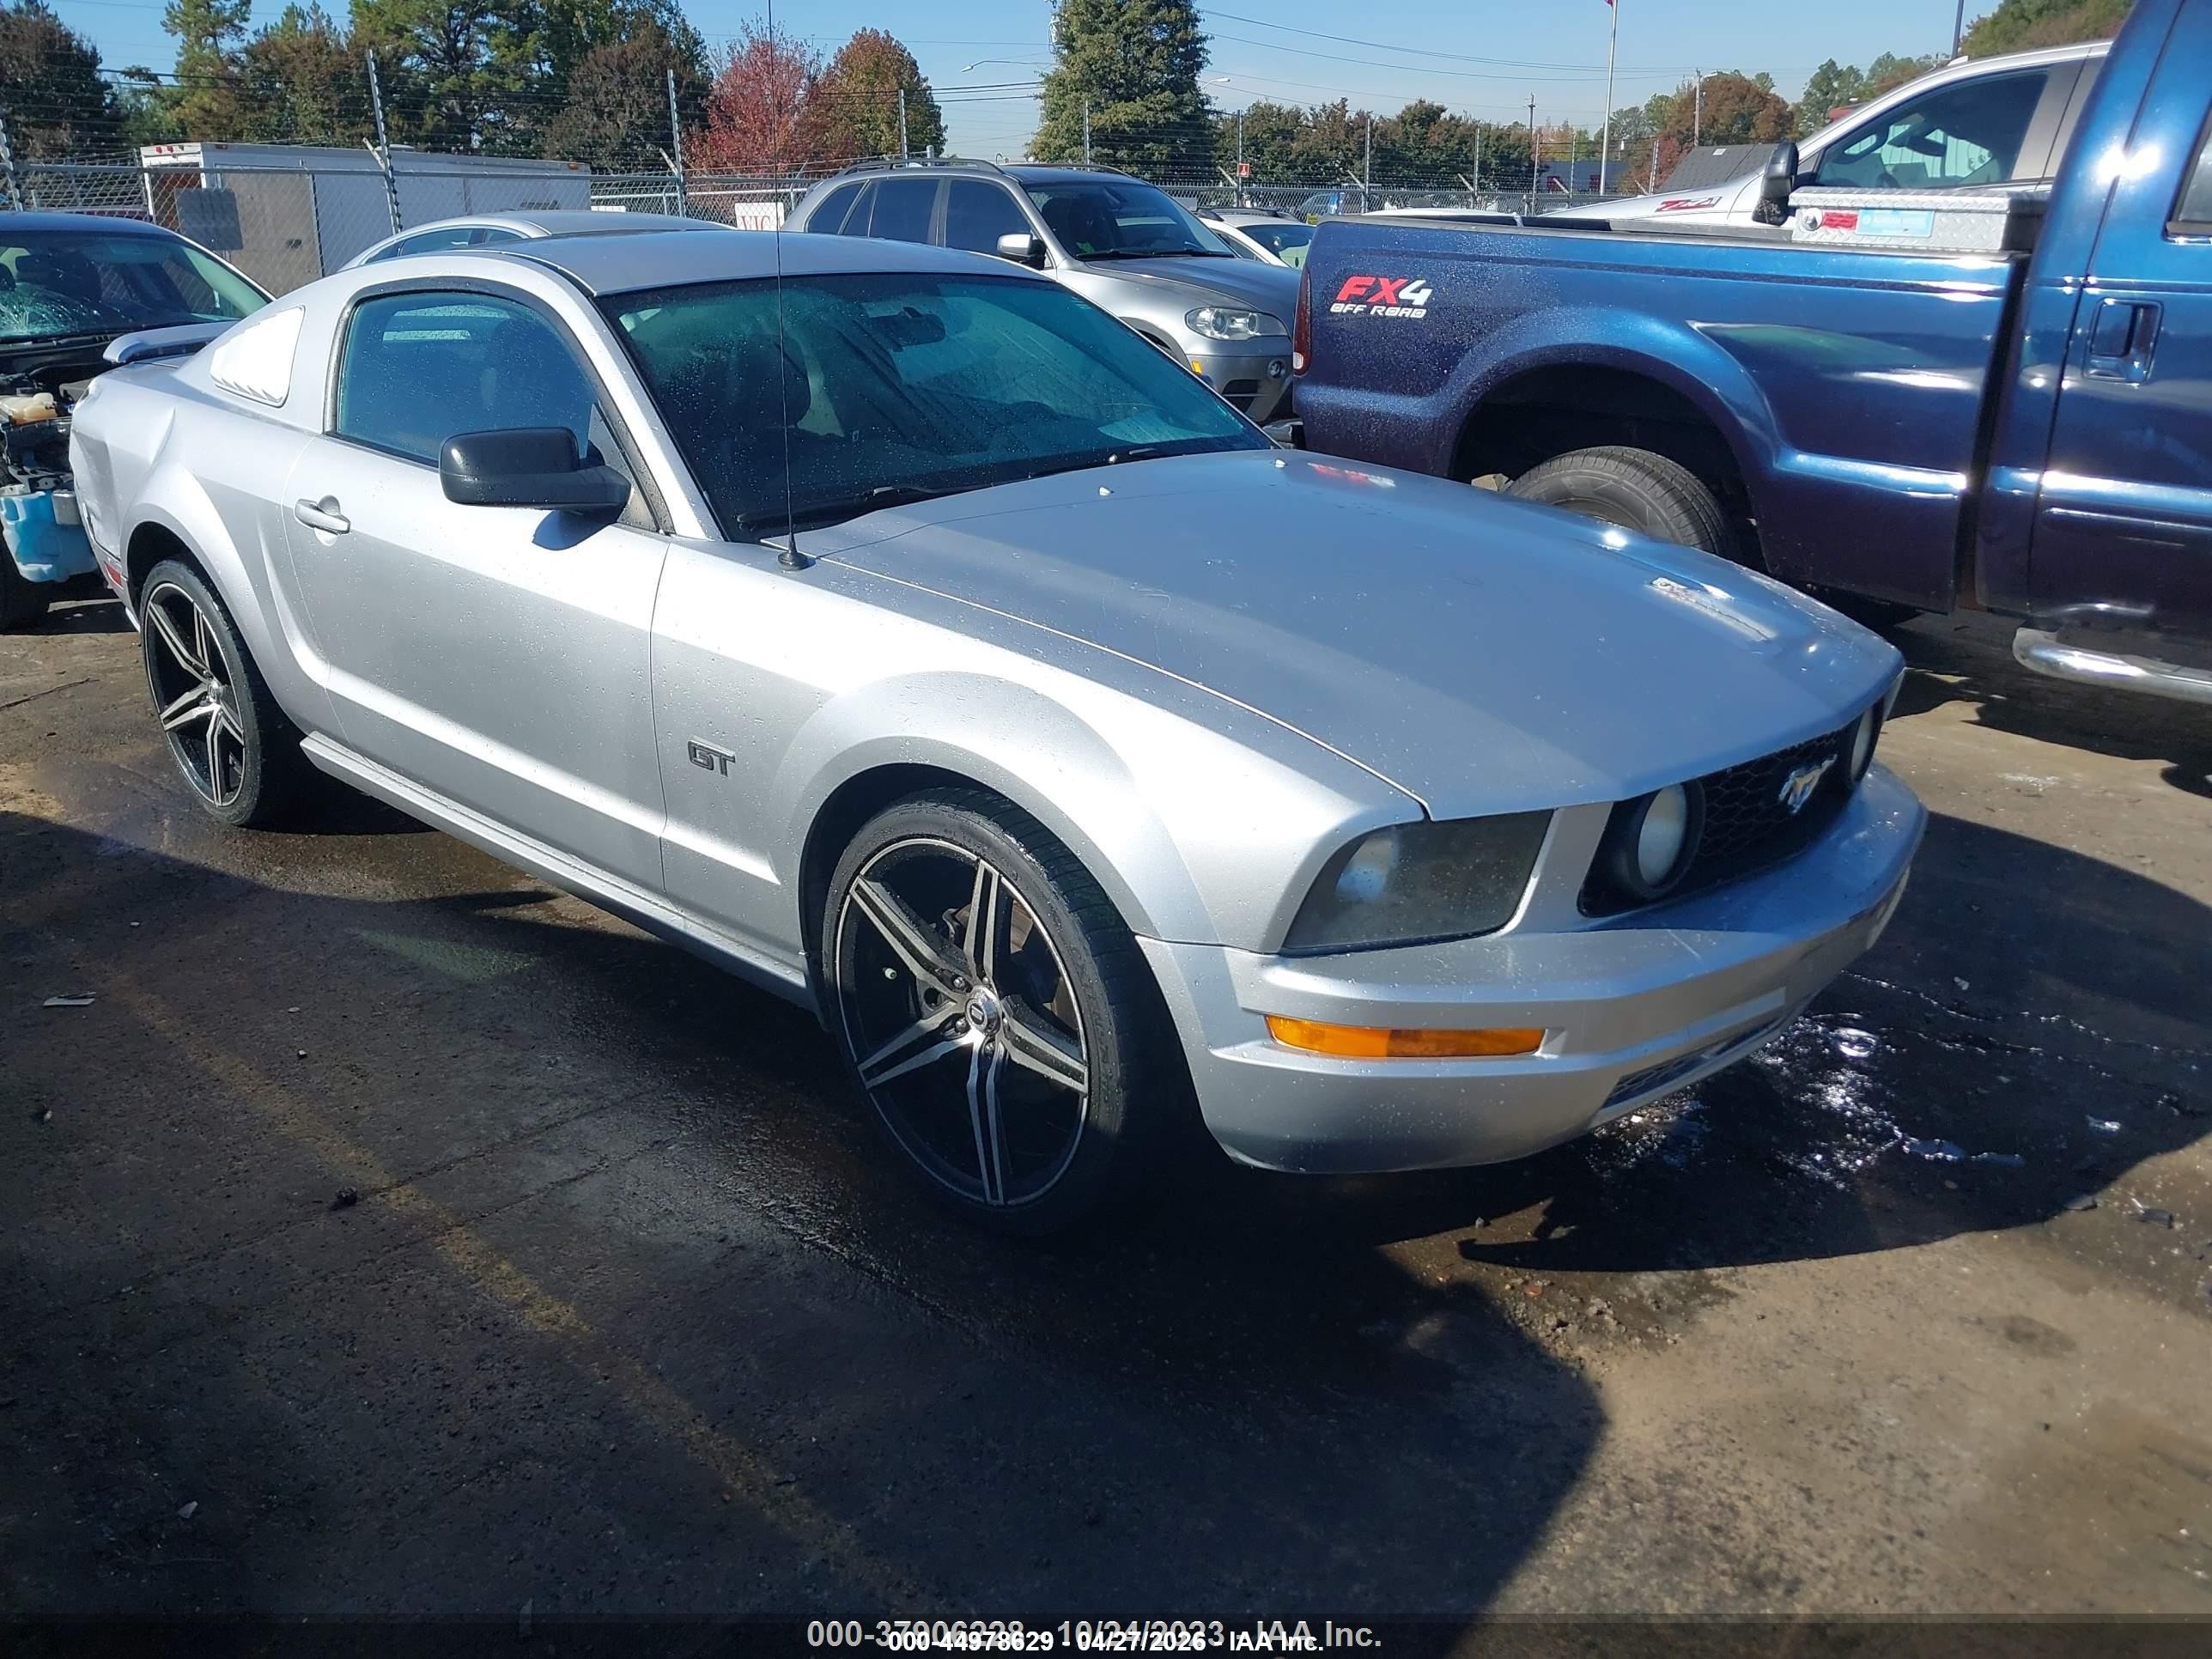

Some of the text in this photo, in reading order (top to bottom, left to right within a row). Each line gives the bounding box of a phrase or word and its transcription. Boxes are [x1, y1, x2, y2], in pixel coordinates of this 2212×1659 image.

[1336, 276, 1433, 307] FX4
[1329, 302, 1427, 319] OFF ROAD
[687, 739, 736, 777] GT
